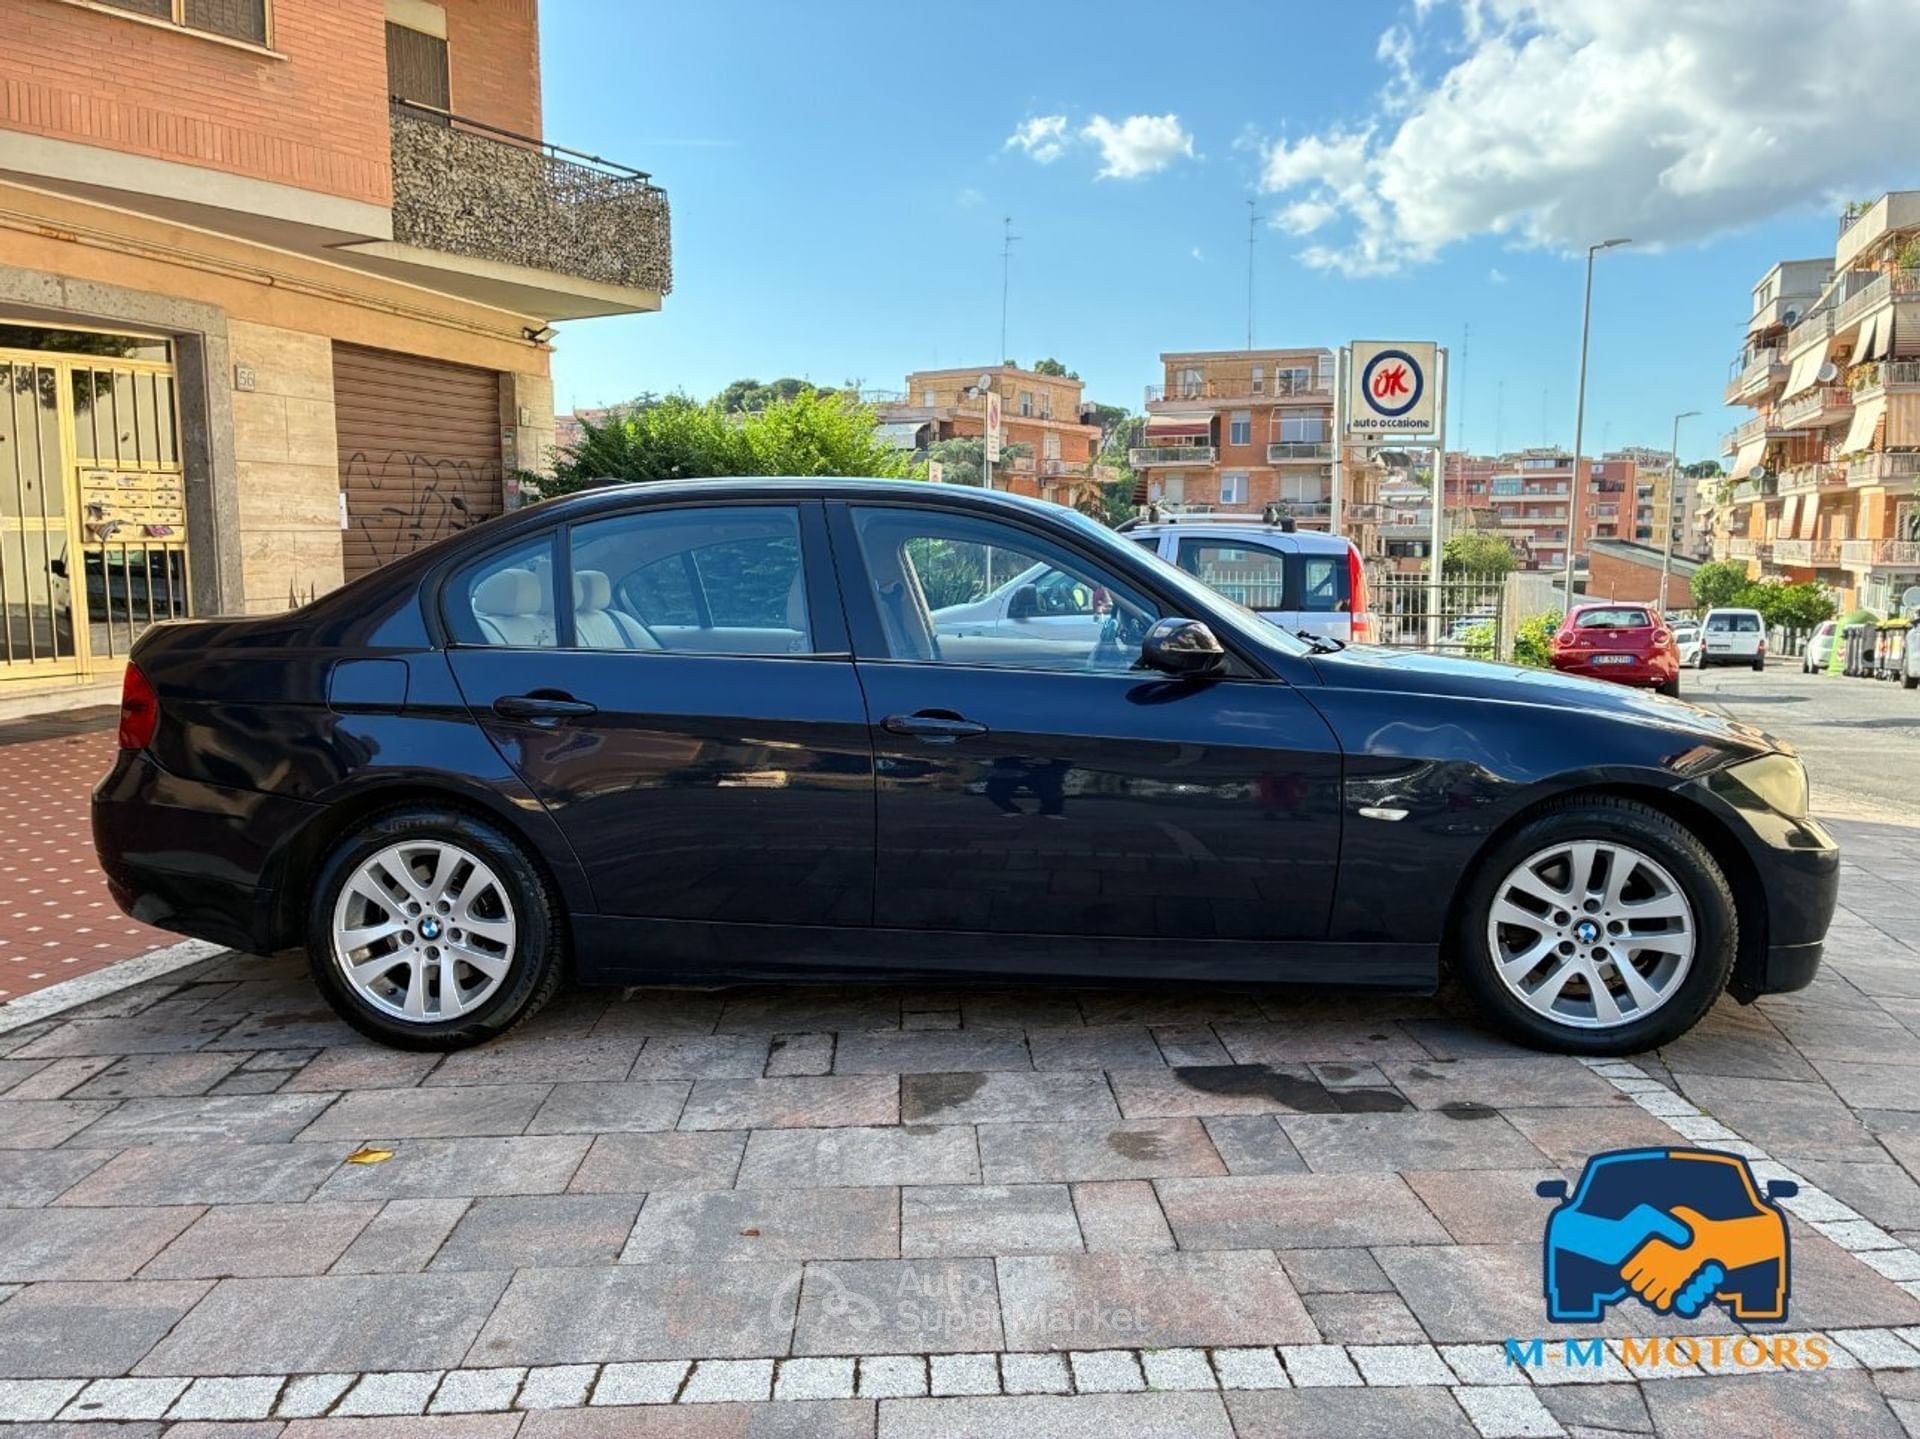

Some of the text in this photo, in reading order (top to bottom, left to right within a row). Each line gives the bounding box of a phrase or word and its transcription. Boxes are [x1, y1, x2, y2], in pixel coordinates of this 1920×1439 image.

[239, 370, 256, 387] 56
[1373, 364, 1409, 398] OK
[1353, 417, 1430, 428] auto occasione
